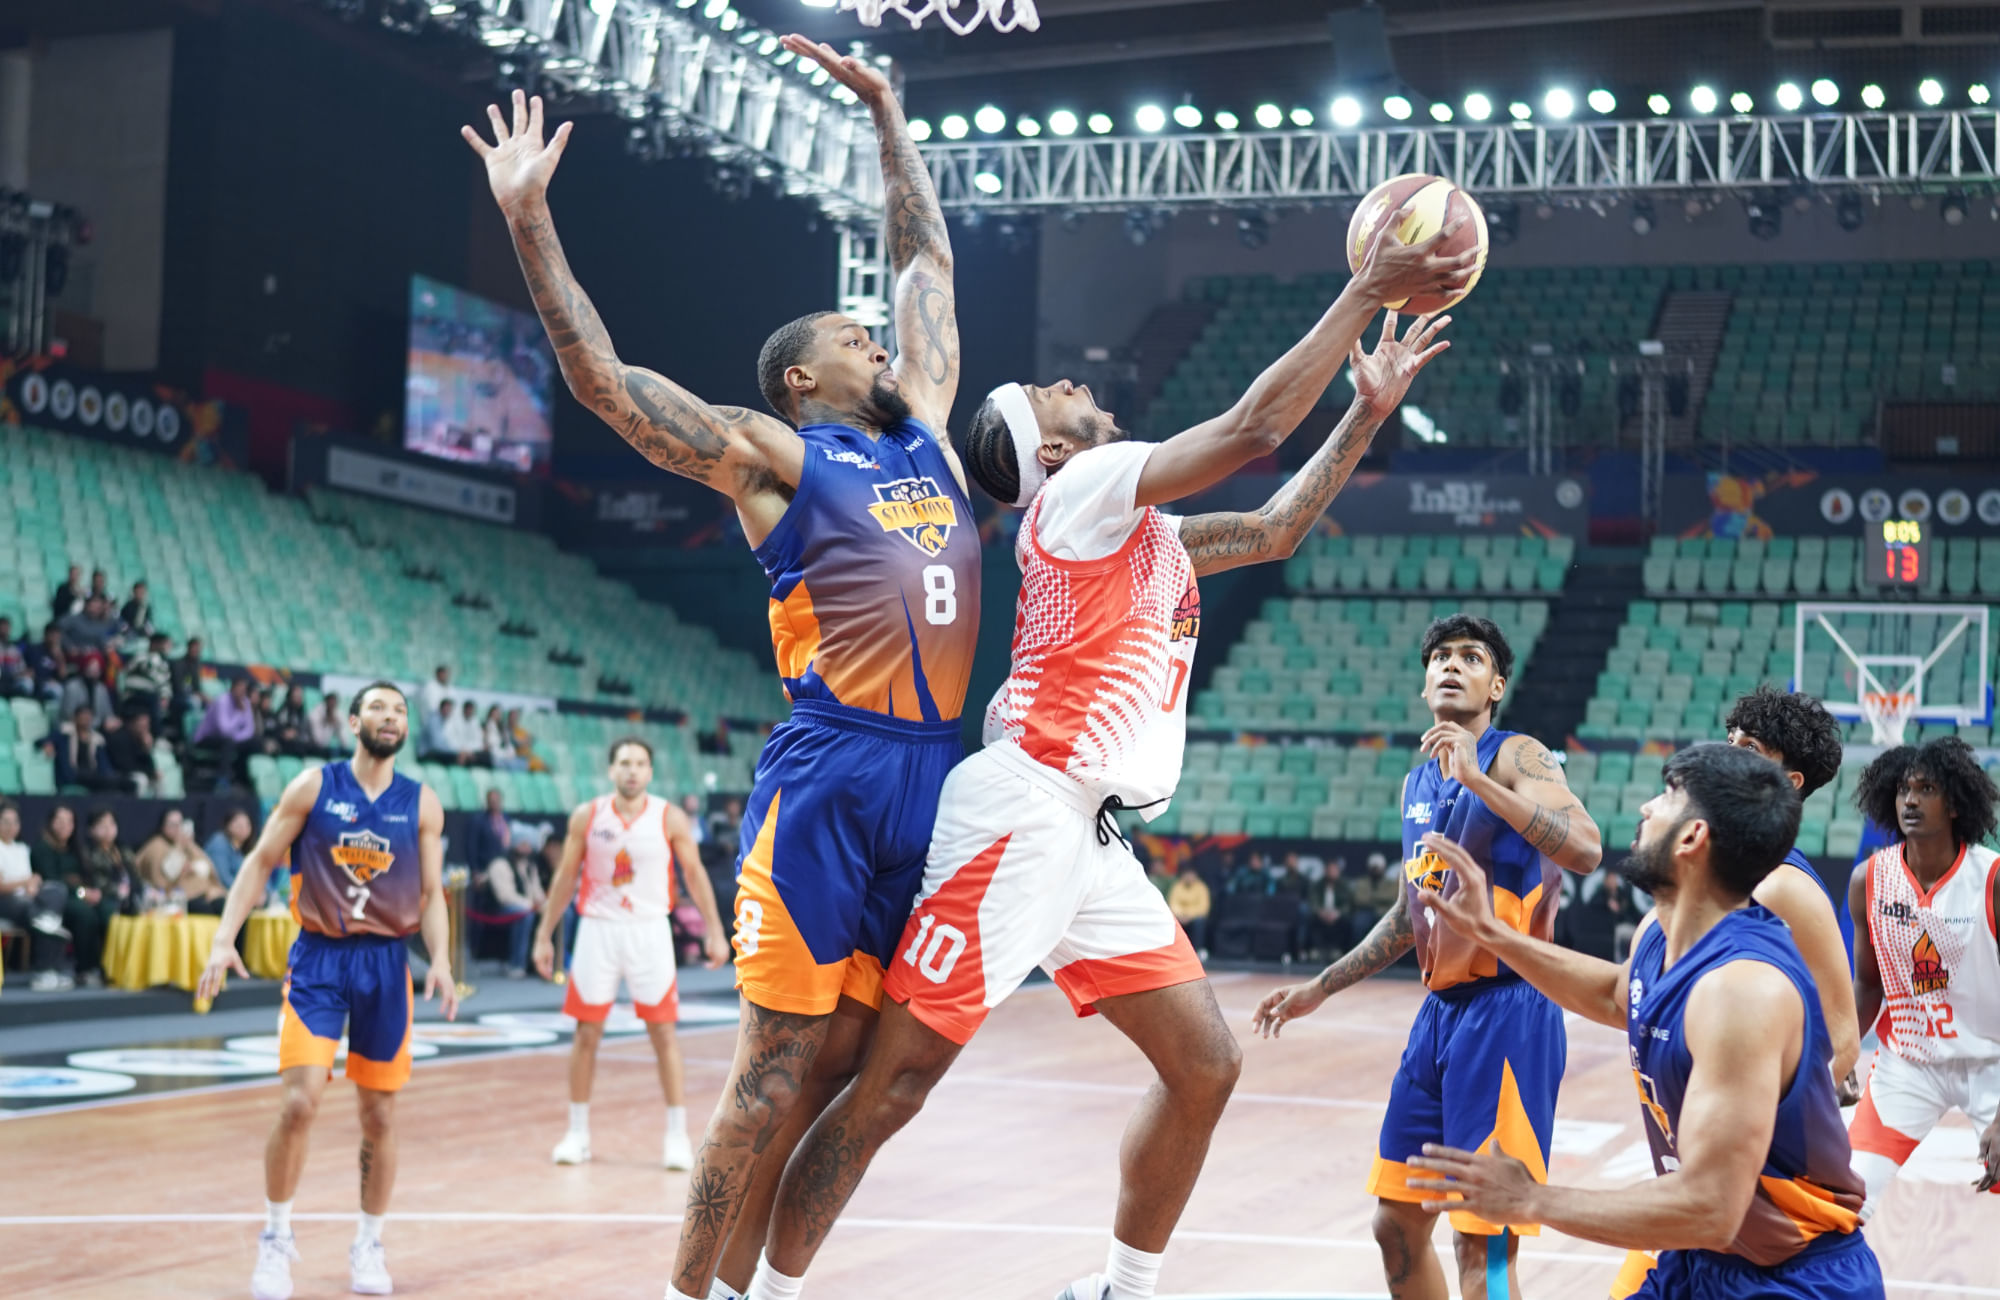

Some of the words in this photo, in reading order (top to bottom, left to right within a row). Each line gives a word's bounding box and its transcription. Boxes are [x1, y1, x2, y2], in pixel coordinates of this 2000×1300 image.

[1886, 545, 1919, 582] 13
[922, 564, 957, 625] 8
[347, 886, 370, 919] 7
[737, 899, 763, 956] 8
[903, 914, 967, 984] 10
[1913, 977, 1949, 996] HEAT
[1923, 1003, 1958, 1038] 12
